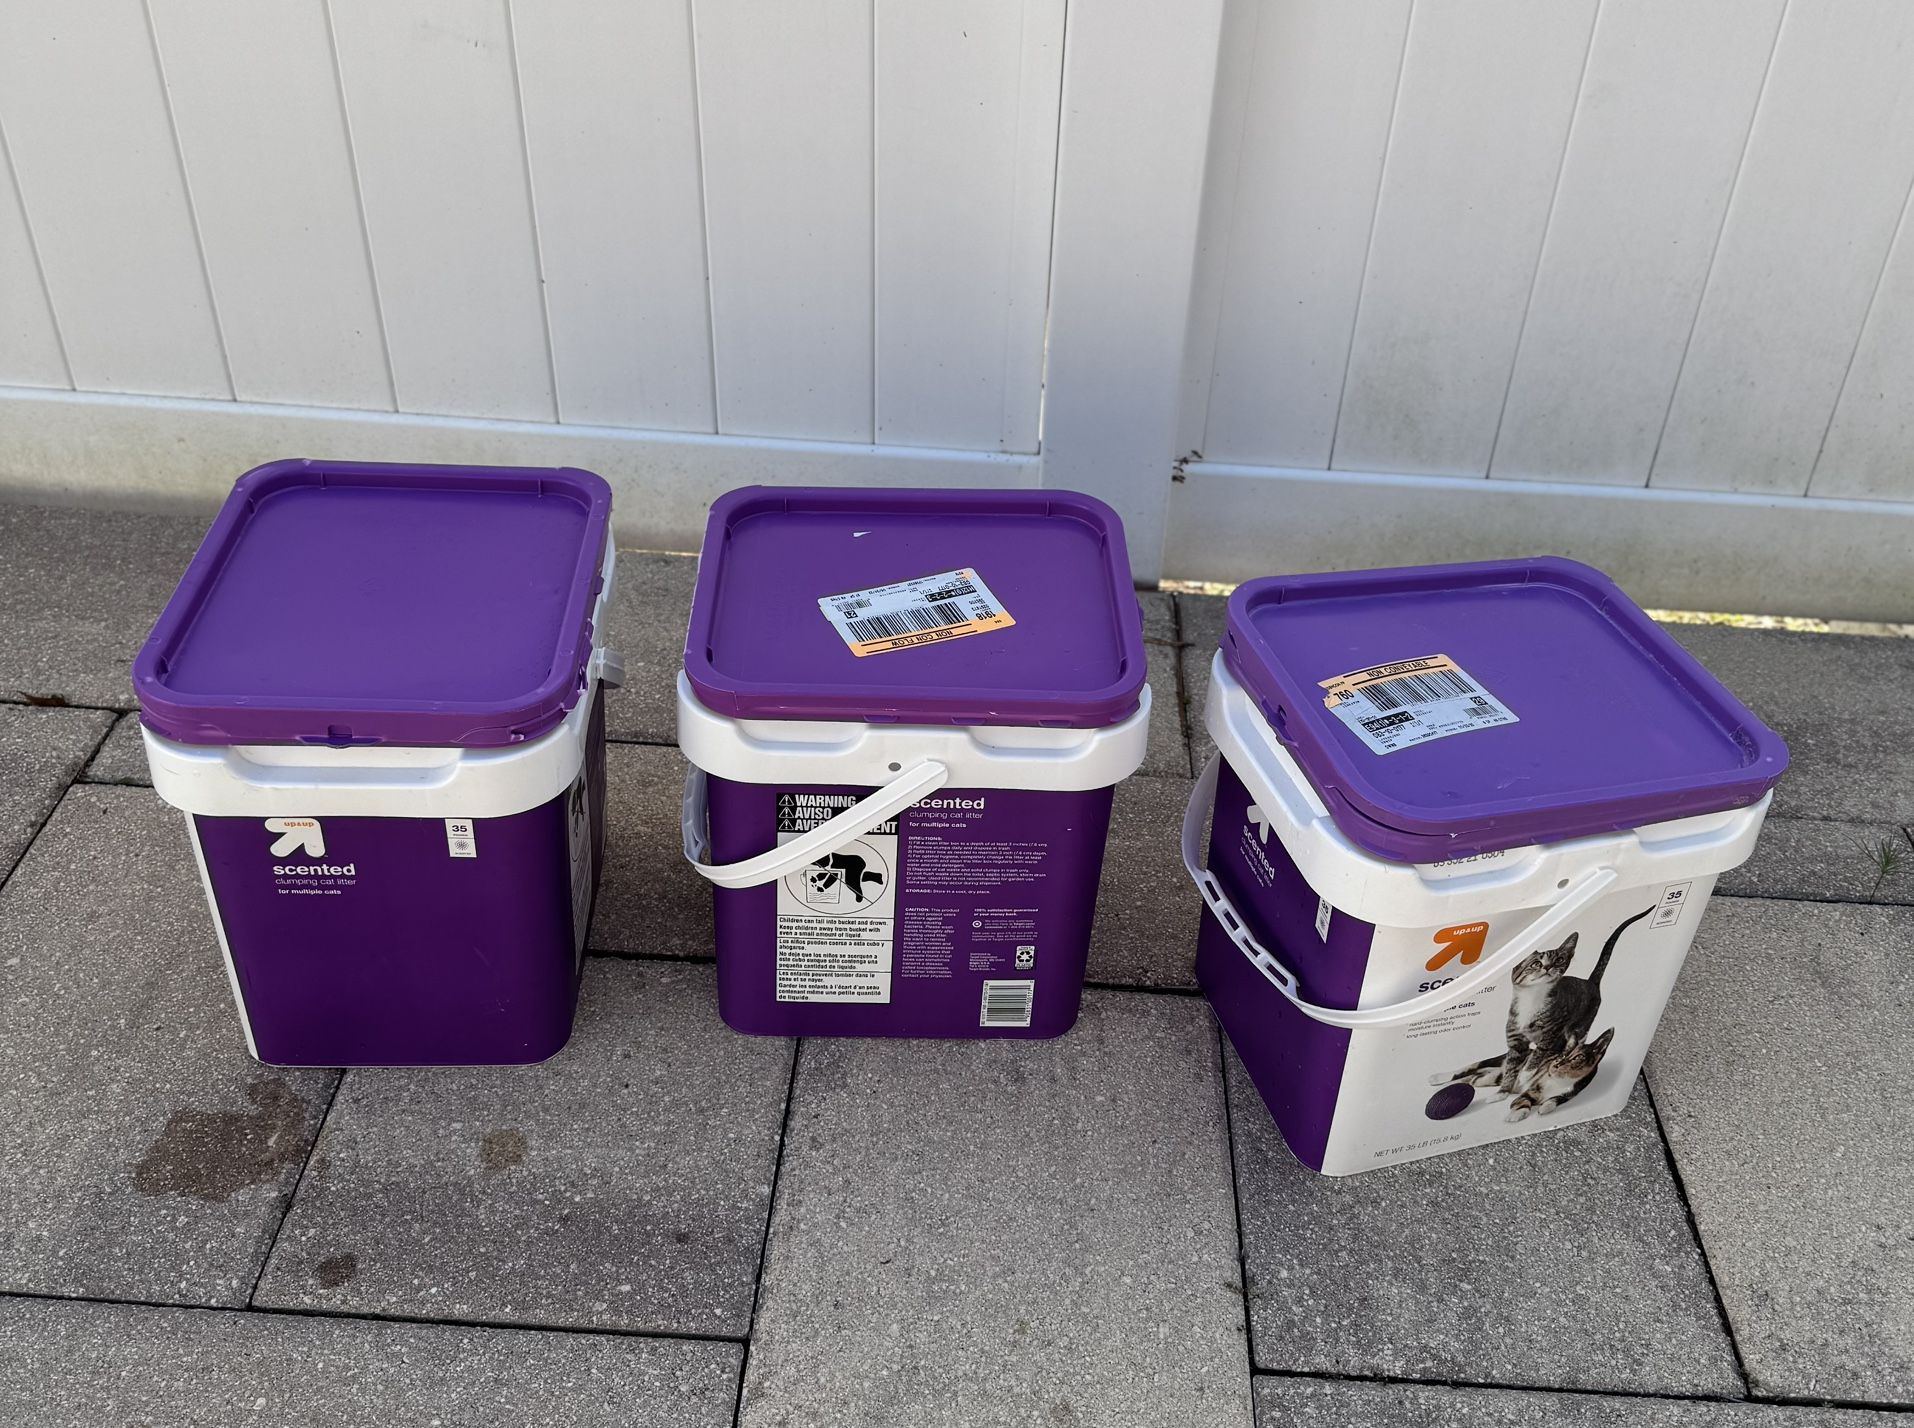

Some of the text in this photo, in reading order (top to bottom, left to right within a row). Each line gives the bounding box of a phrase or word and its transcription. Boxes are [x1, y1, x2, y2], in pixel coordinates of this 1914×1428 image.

[976, 610, 996, 621] 1918
[890, 629, 954, 647] NON CON FLOW
[1366, 660, 1430, 678] NON CONVEYABLE
[1333, 689, 1355, 702] 760
[794, 794, 857, 809] WARNING
[909, 797, 985, 810] scented
[794, 807, 832, 820] AVISO
[909, 811, 948, 822] clumping
[965, 811, 984, 819] litter
[451, 824, 468, 833] 35
[921, 821, 950, 829] multiple
[272, 863, 356, 876] scented
[275, 878, 318, 887] clumping
[336, 878, 356, 886] litter
[1666, 890, 1683, 900] 35
[1453, 925, 1484, 936] up&up
[1458, 1001, 1476, 1010] cats
[1373, 1148, 1390, 1158] NET
[1405, 1144, 1416, 1152] 35
[1417, 1140, 1429, 1149] LB
